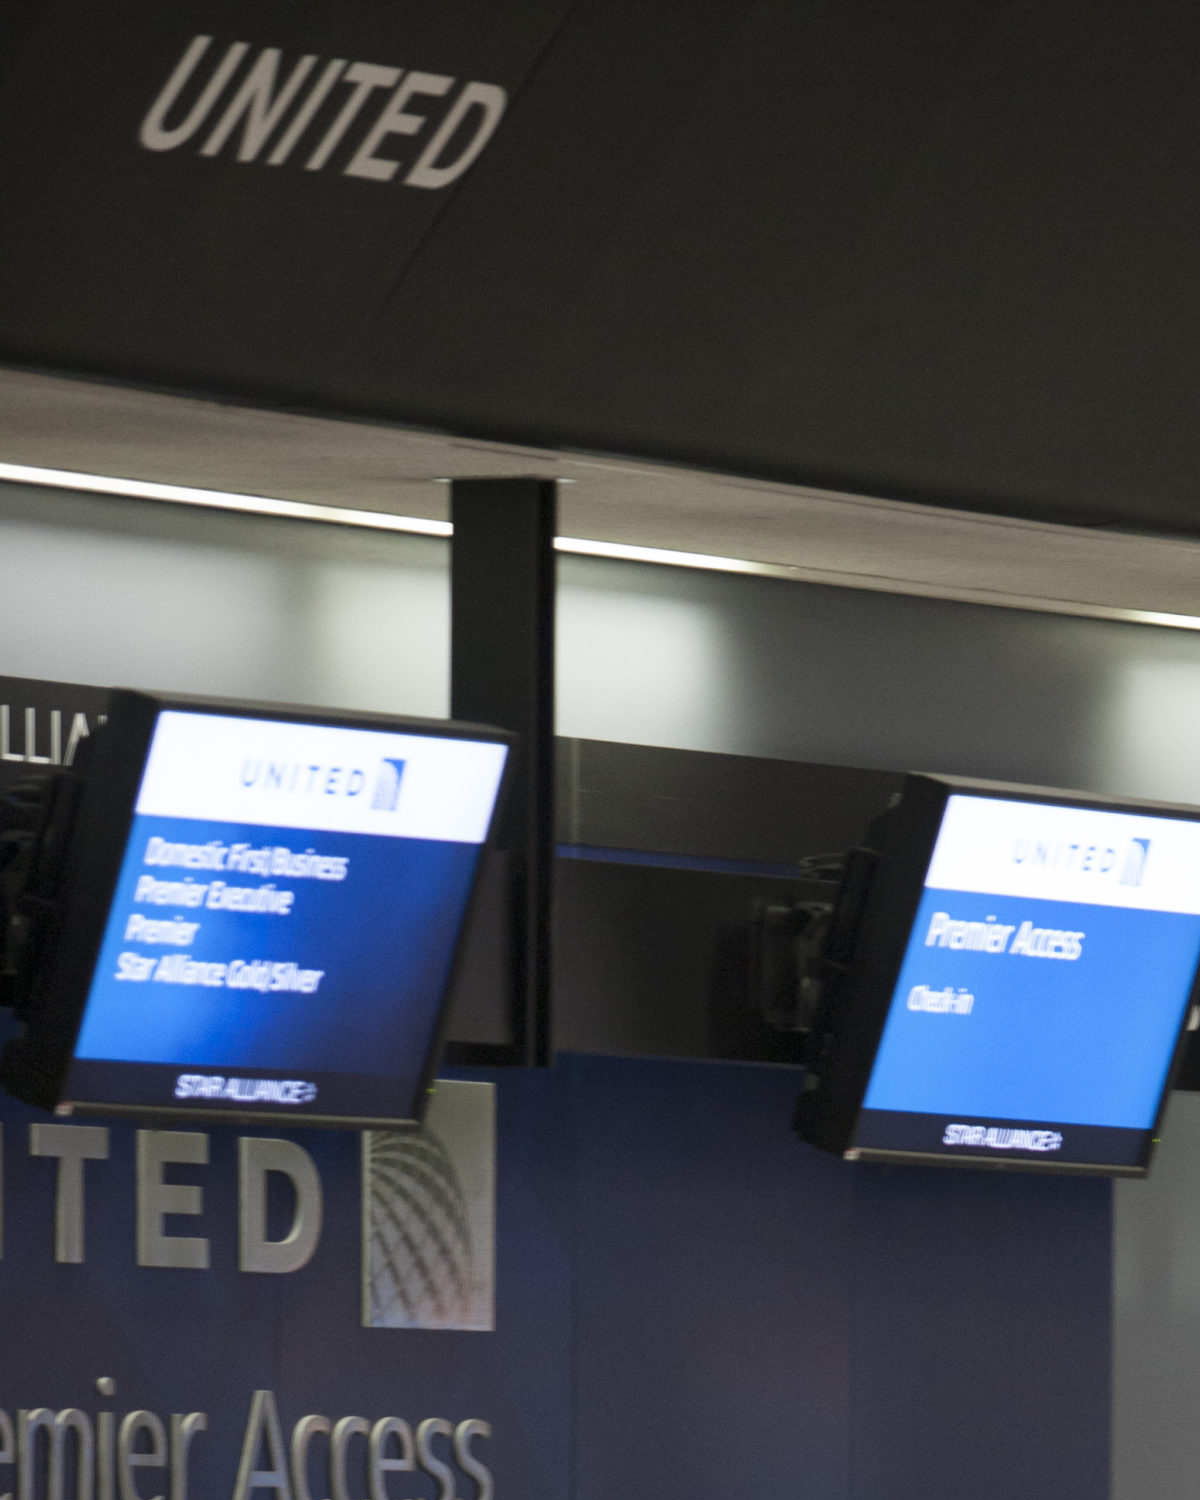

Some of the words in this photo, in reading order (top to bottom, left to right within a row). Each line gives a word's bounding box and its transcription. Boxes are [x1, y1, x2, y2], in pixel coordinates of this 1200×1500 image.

[139, 35, 508, 190] UNITED
[0, 704, 108, 766] LLIA
[240, 757, 366, 798] UNITED
[144, 836, 229, 871] Domestic
[1012, 838, 1116, 874] UNITED
[133, 874, 209, 908] Premier
[205, 880, 295, 915] Executive
[124, 913, 201, 947] Premier
[924, 911, 1015, 955] Premier
[1009, 920, 1086, 961] Access
[114, 951, 158, 982] Star
[153, 953, 227, 988] Alliance
[906, 984, 975, 1015] Check-in
[174, 1074, 226, 1099] STAR
[222, 1077, 309, 1104] ALLIANCE
[943, 1124, 987, 1146] STAR
[984, 1126, 1054, 1152] ALLIANCE
[0, 1121, 324, 1274] TED
